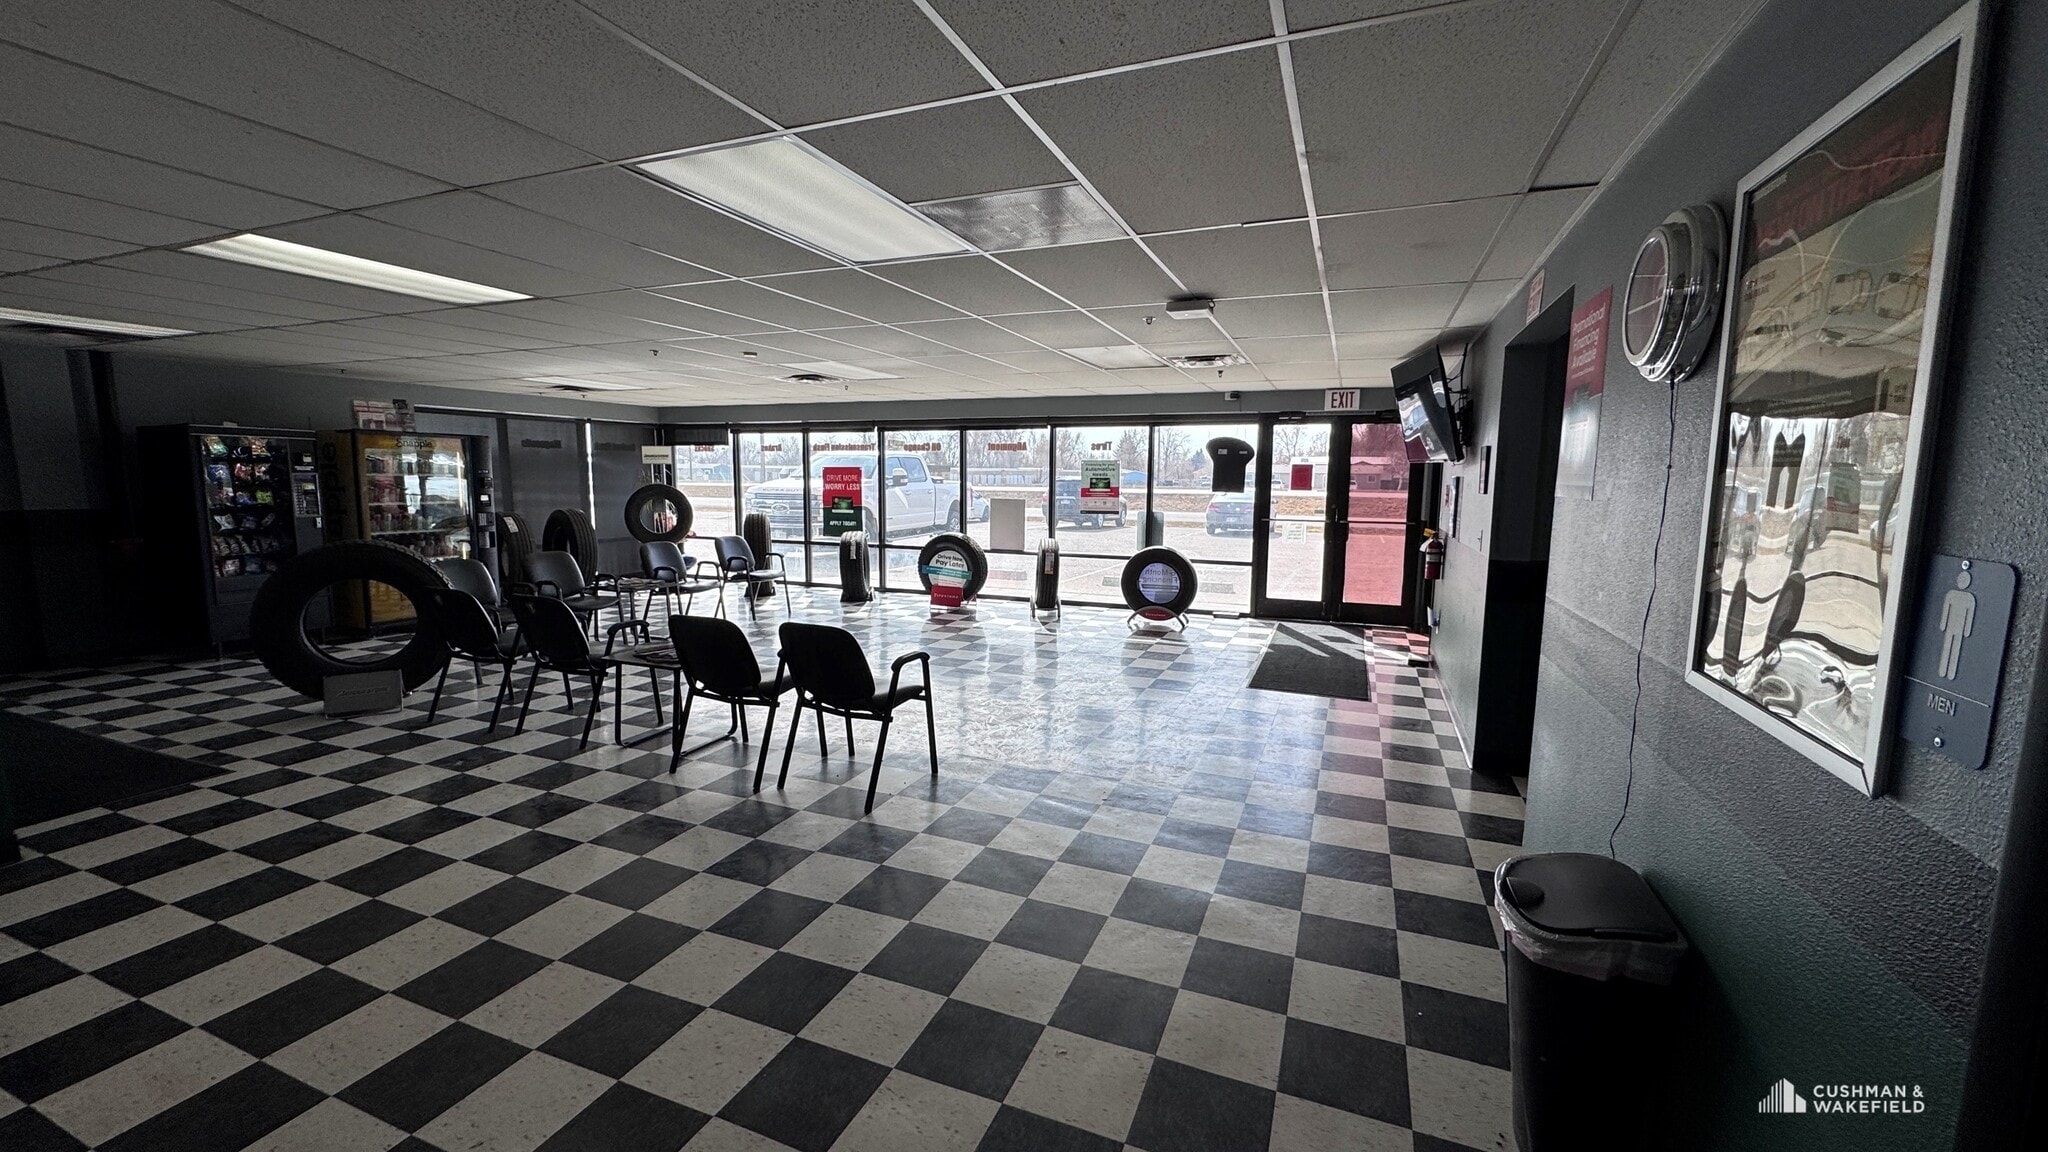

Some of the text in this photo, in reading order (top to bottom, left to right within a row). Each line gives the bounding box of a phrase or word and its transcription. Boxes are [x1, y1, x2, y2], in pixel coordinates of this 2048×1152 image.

[1572, 302, 1605, 336] Promotional
[1572, 327, 1599, 352] Financing
[1571, 345, 1597, 368] Available
[1331, 391, 1355, 408] EXIT
[395, 438, 432, 450] Snapple
[935, 559, 948, 567] Pay
[1926, 693, 1956, 717] MEN
